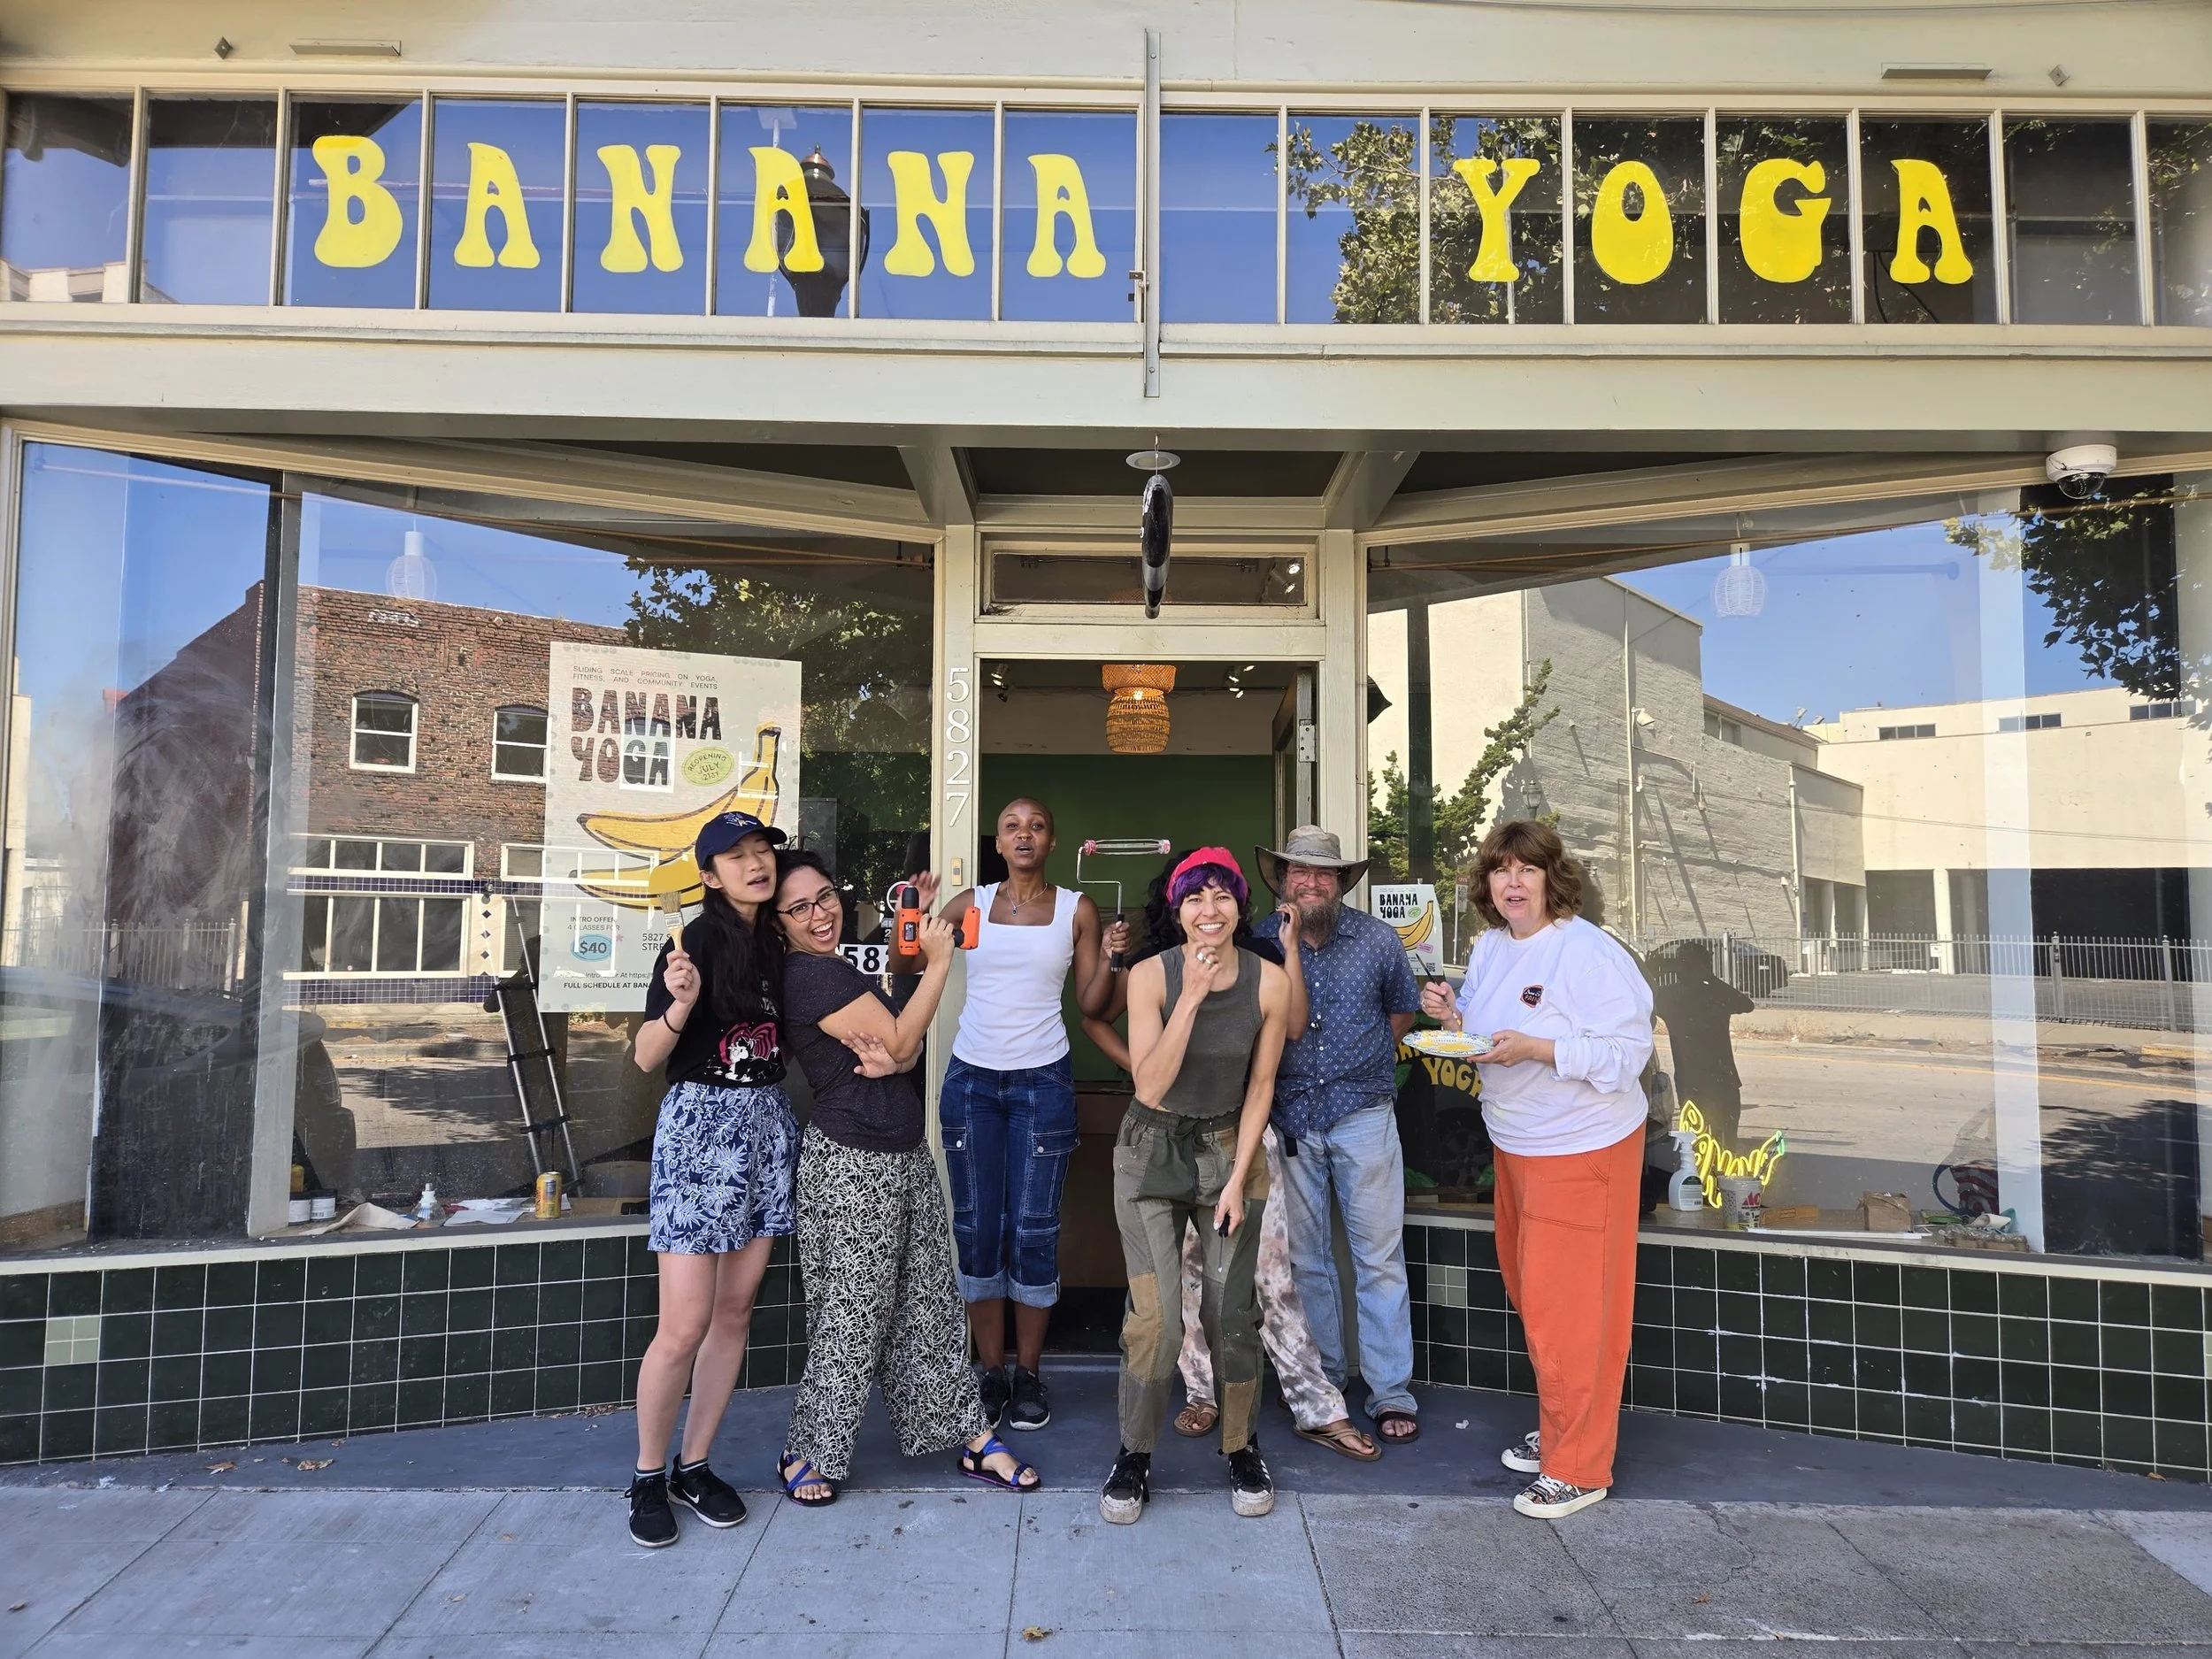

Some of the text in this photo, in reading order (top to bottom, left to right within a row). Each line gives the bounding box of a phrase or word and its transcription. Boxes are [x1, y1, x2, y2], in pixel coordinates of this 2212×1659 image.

[312, 134, 1974, 284] BANANA YOGA
[572, 665, 603, 674] SLIDING
[610, 668, 634, 677] SCALE
[695, 674, 718, 683] YOGA,
[572, 673, 605, 683] FITNESS,
[637, 679, 683, 687] COMMUNITY
[690, 681, 718, 690] EVENTS
[571, 687, 722, 741] BANANA
[946, 667, 971, 827] 5827
[571, 736, 670, 787] YOGA
[687, 752, 727, 772] REOPENING
[697, 761, 720, 776] JULY
[1379, 893, 1418, 906] BANANA
[1379, 906, 1406, 919] YOGA
[641, 933, 664, 941] 5827
[579, 941, 607, 956] $40
[641, 942, 664, 951] STRE
